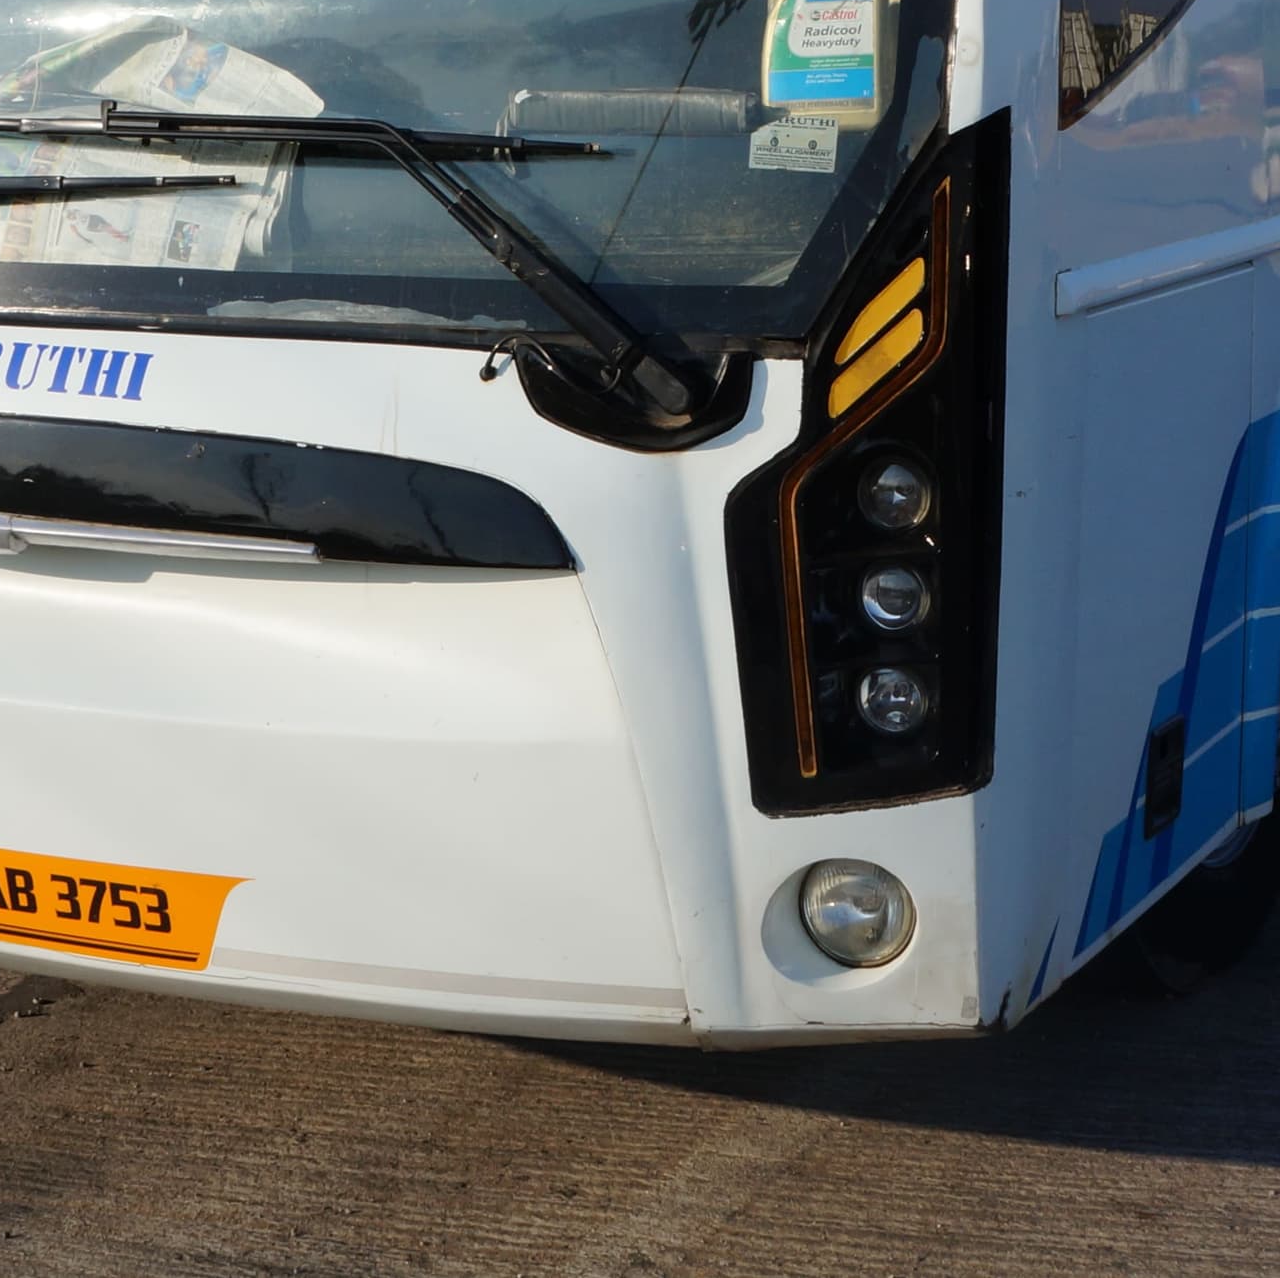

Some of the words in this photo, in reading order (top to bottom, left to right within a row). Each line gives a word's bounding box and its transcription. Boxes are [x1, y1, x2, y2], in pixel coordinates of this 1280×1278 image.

[822, 9, 858, 20] Castrol
[804, 25, 862, 37] Radicool
[802, 38, 861, 49] Heavyduty
[756, 146, 782, 154] WHEEL
[785, 148, 832, 157] ALIGNMENT
[50, 873, 172, 934] 3753
